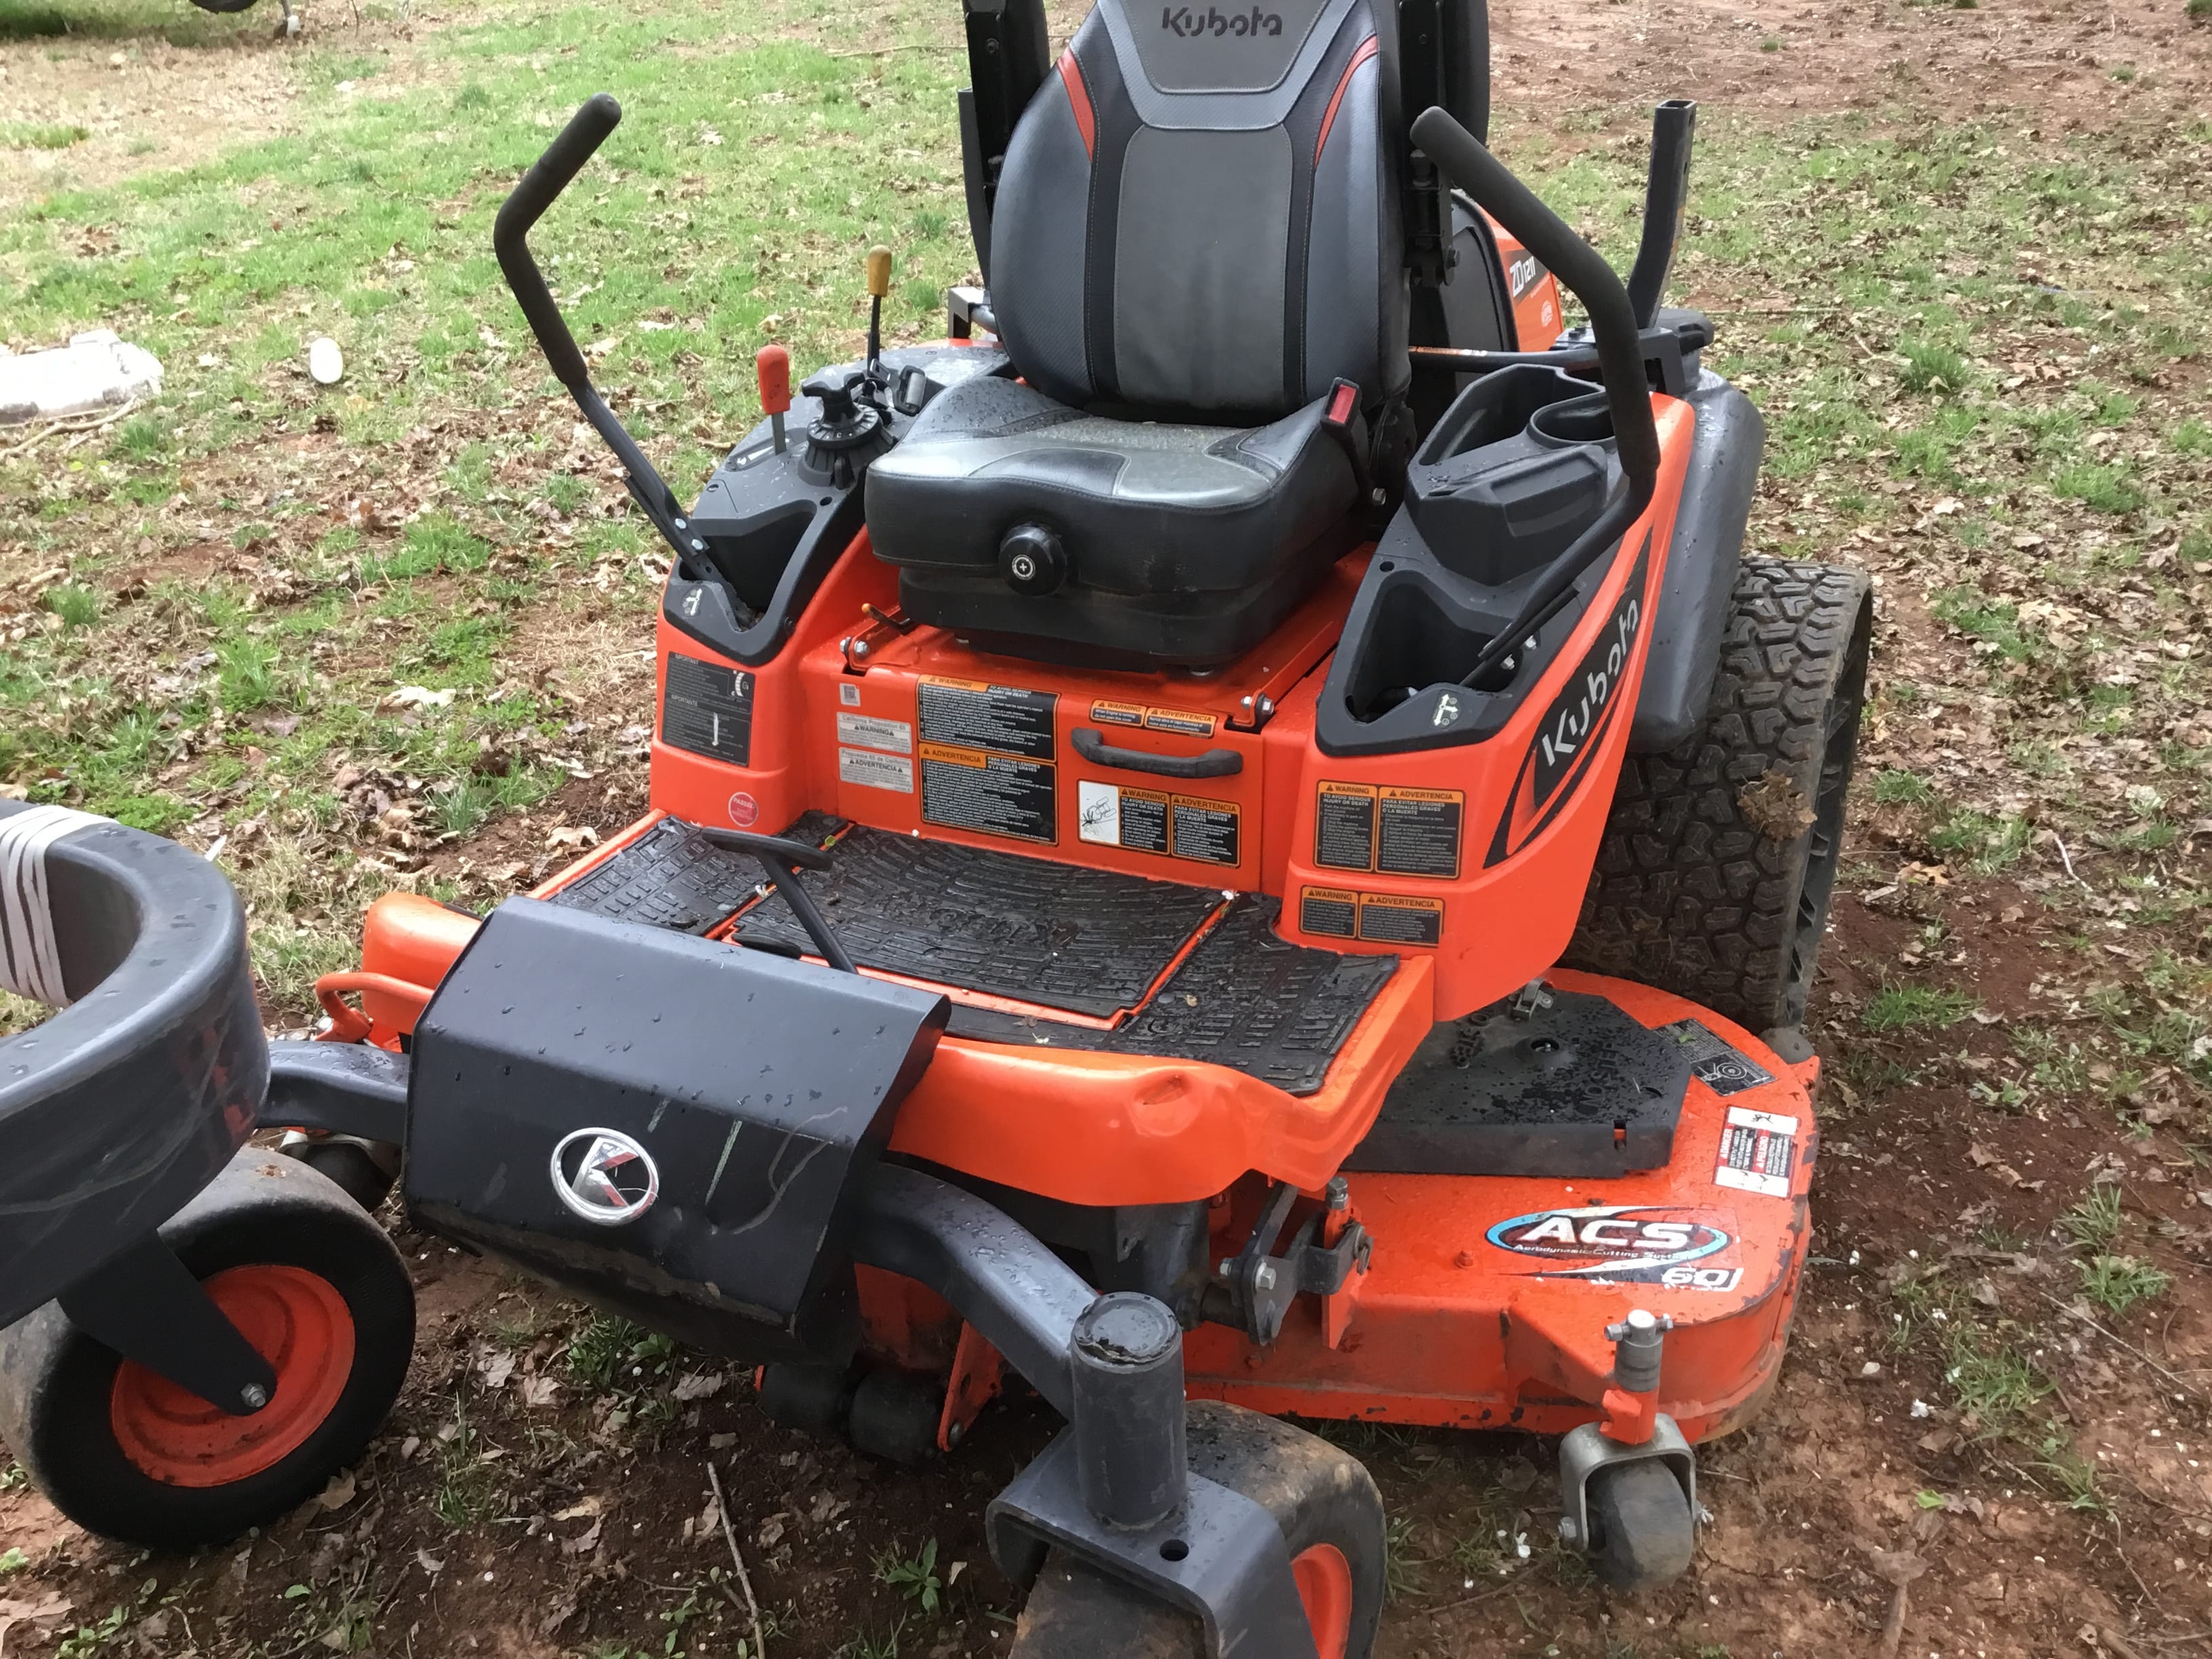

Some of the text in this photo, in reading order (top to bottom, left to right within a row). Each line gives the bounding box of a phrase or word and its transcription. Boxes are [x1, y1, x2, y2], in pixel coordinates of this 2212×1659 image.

[1162, 5, 1282, 37] Kubota
[939, 678, 972, 687] WARNING
[1542, 599, 1638, 766] Kubota
[1107, 703, 1141, 712] WARNING
[1160, 710, 1211, 722] ADVERTENCIA
[860, 725, 889, 735] WARNING
[932, 750, 981, 762] ADVERTENCIA
[855, 760, 897, 771] ADVERTENCIA
[1335, 785, 1370, 794] WARNING
[1128, 790, 1166, 801] WARNING
[1400, 791, 1453, 800] ADVERTENCIA
[1181, 798, 1236, 812] ADVERTENCIA
[1315, 890, 1352, 901] WARNING
[1376, 897, 1435, 907] ADVERTENCIA
[1756, 1136, 1769, 1162] PELIGRO
[1517, 1216, 1694, 1249] ACS
[1513, 1244, 1589, 1254] Aerodynamic
[1593, 1248, 1639, 1258] Cutting
[1661, 1267, 1729, 1286] 60
